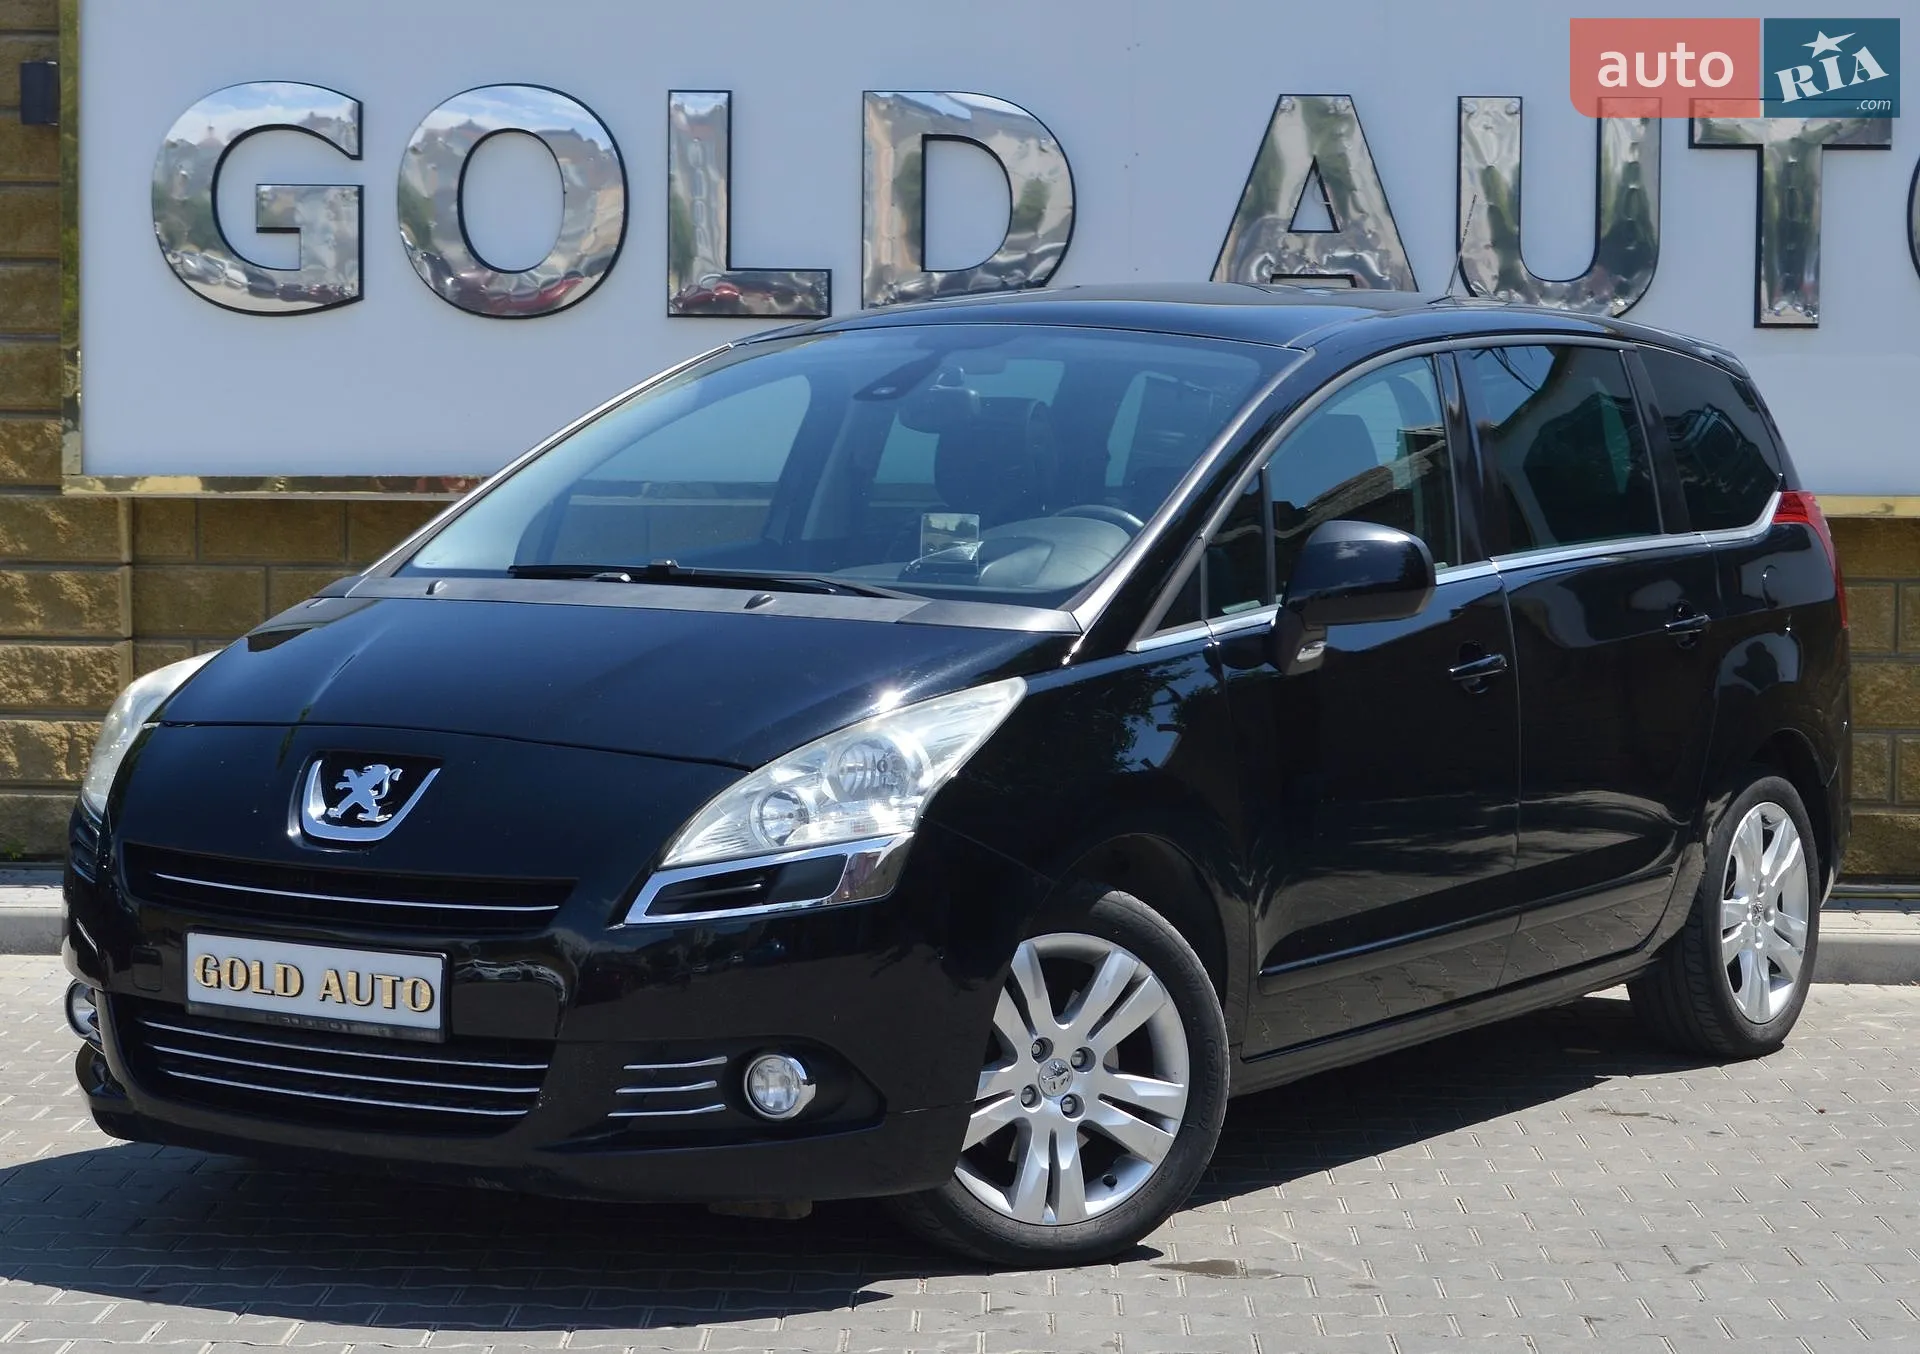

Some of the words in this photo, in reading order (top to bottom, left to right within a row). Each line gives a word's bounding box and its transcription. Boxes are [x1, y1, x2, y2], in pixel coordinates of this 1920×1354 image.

[151, 81, 1076, 318] GOLD
[1211, 94, 1920, 328] AUT
[193, 953, 304, 998] GOLD
[319, 968, 435, 1013] AUTO
